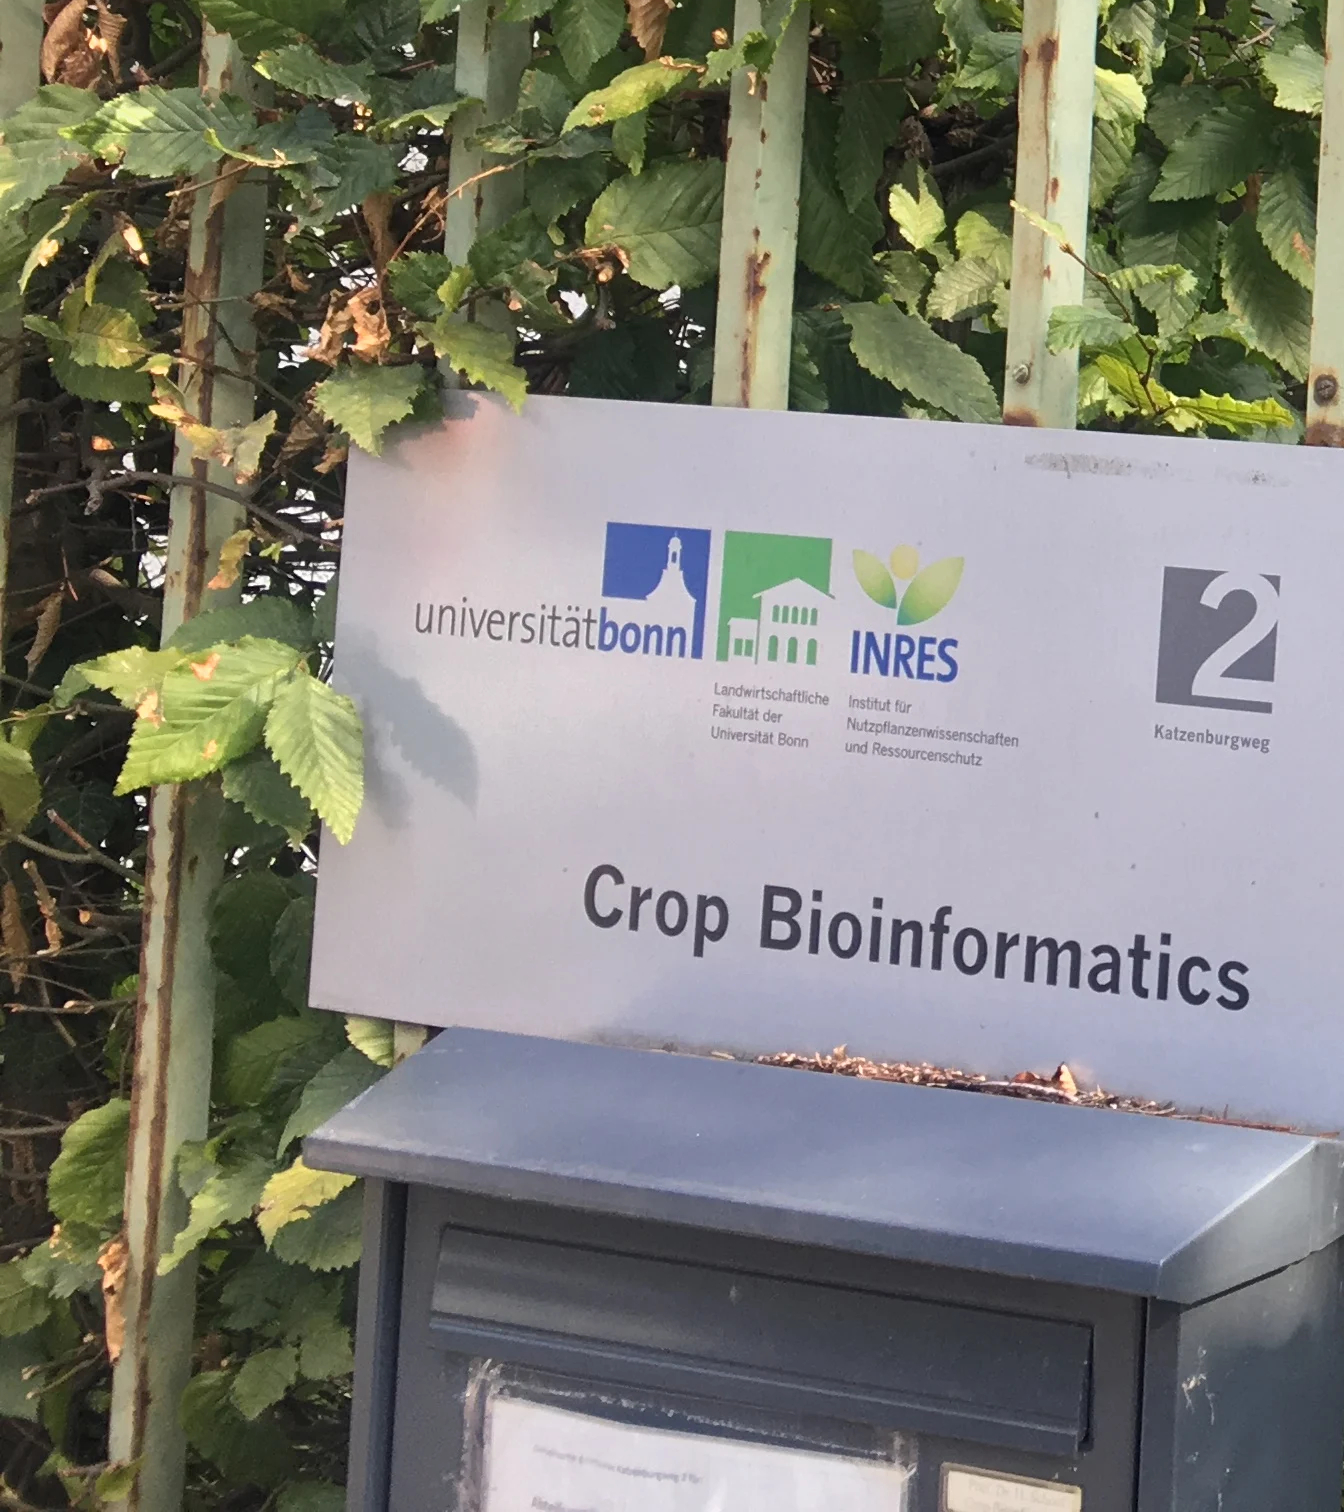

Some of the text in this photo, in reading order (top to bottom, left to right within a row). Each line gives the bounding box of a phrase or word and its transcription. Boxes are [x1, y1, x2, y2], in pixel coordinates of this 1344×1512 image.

[1190, 569, 1280, 704] 2
[850, 629, 959, 683] INRES
[713, 682, 830, 707] Landwirtschaftliche
[848, 694, 913, 715] Institut für
[712, 704, 783, 724] Fakultät der
[710, 726, 809, 748] Universität Bonn
[846, 717, 1020, 748] Nutzpflanzenwissenschaften
[1154, 723, 1271, 754] Katzenburgweg
[844, 741, 983, 767] und Ressourcenschutz
[583, 863, 1252, 1012] Crop Bioinformatics
